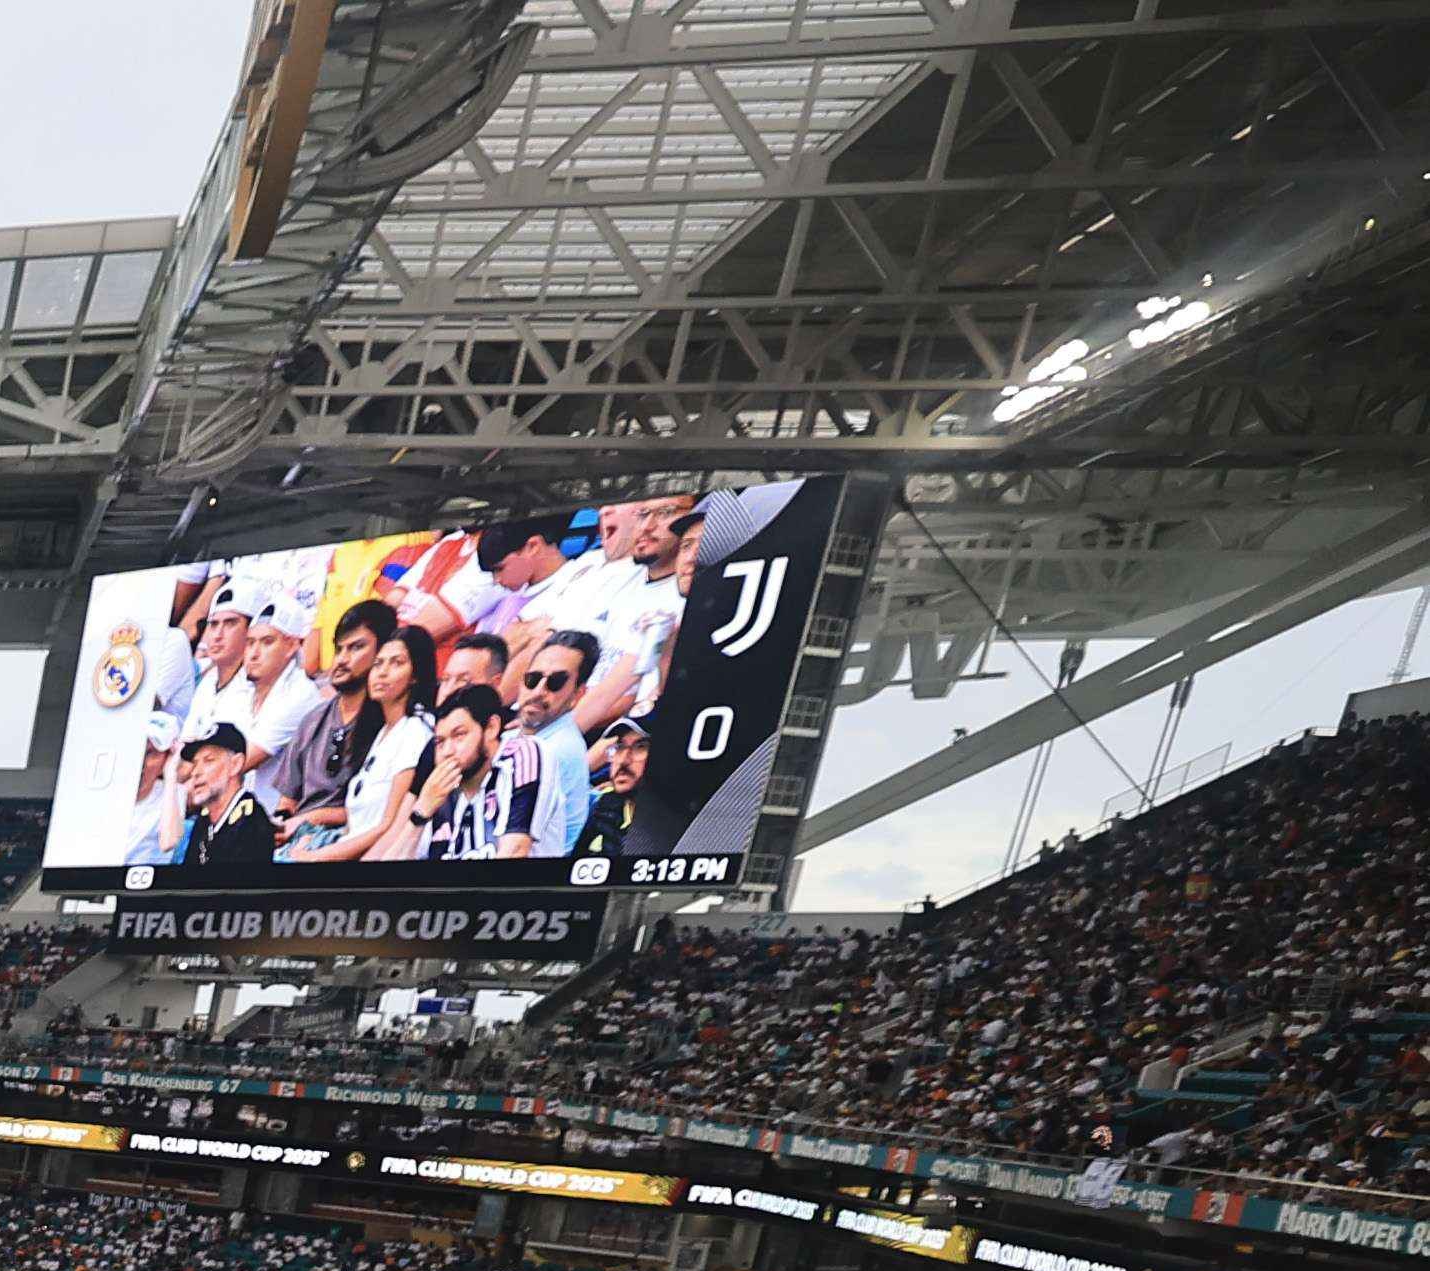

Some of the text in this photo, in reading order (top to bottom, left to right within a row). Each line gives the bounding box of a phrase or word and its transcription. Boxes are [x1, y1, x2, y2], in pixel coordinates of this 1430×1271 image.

[687, 705, 734, 760] 0
[130, 870, 151, 884] CC
[577, 864, 604, 880] CC
[630, 857, 729, 882] 3:13 PM
[117, 911, 177, 938] FIFA
[183, 911, 263, 939] CLUB
[270, 909, 390, 939] WORLD
[396, 910, 470, 940] CUP
[129, 1133, 160, 1151] FIFA
[160, 1136, 198, 1154] CLUB
[198, 1140, 251, 1159] WORLD
[251, 1144, 284, 1162] CUP
[1275, 1202, 1335, 1240] MARK
[1334, 1211, 1406, 1252] DUPER
